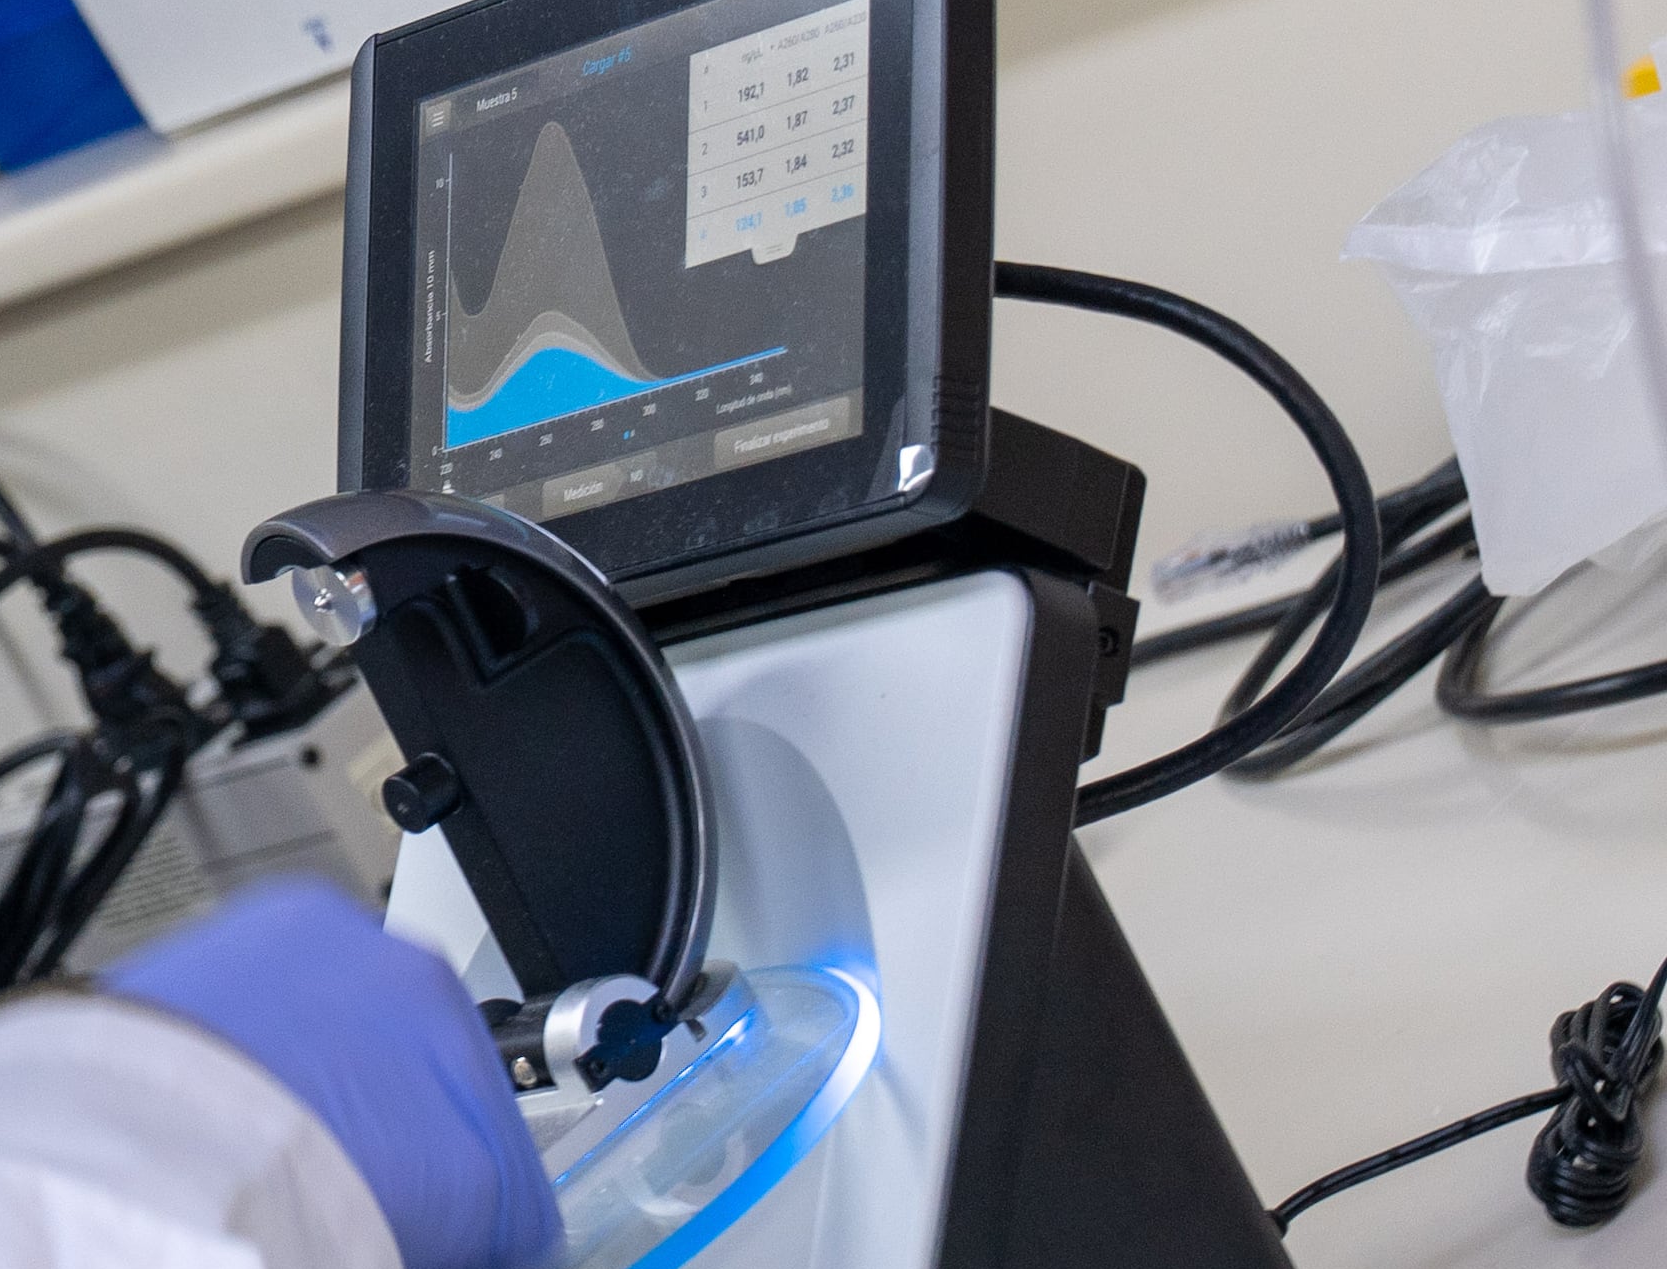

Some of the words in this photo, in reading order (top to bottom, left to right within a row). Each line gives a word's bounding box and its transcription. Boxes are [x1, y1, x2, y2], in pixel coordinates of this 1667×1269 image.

[582, 55, 614, 77] Cargar
[738, 82, 765, 103] 192,1
[787, 67, 810, 89] 1,82
[833, 51, 856, 72] 2,31
[476, 90, 511, 113] Muestra
[511, 87, 518, 101] 5
[701, 142, 709, 156] 2
[736, 125, 765, 147] 541,0
[786, 110, 808, 131] 1,87
[832, 94, 855, 115] 2,37
[700, 185, 708, 199] 3
[736, 168, 764, 189] 153,7
[786, 154, 807, 175] 1,84
[831, 139, 855, 159] 2,32
[428, 250, 435, 274] mm
[426, 275, 434, 290] 10
[424, 291, 434, 363] Absorbancia
